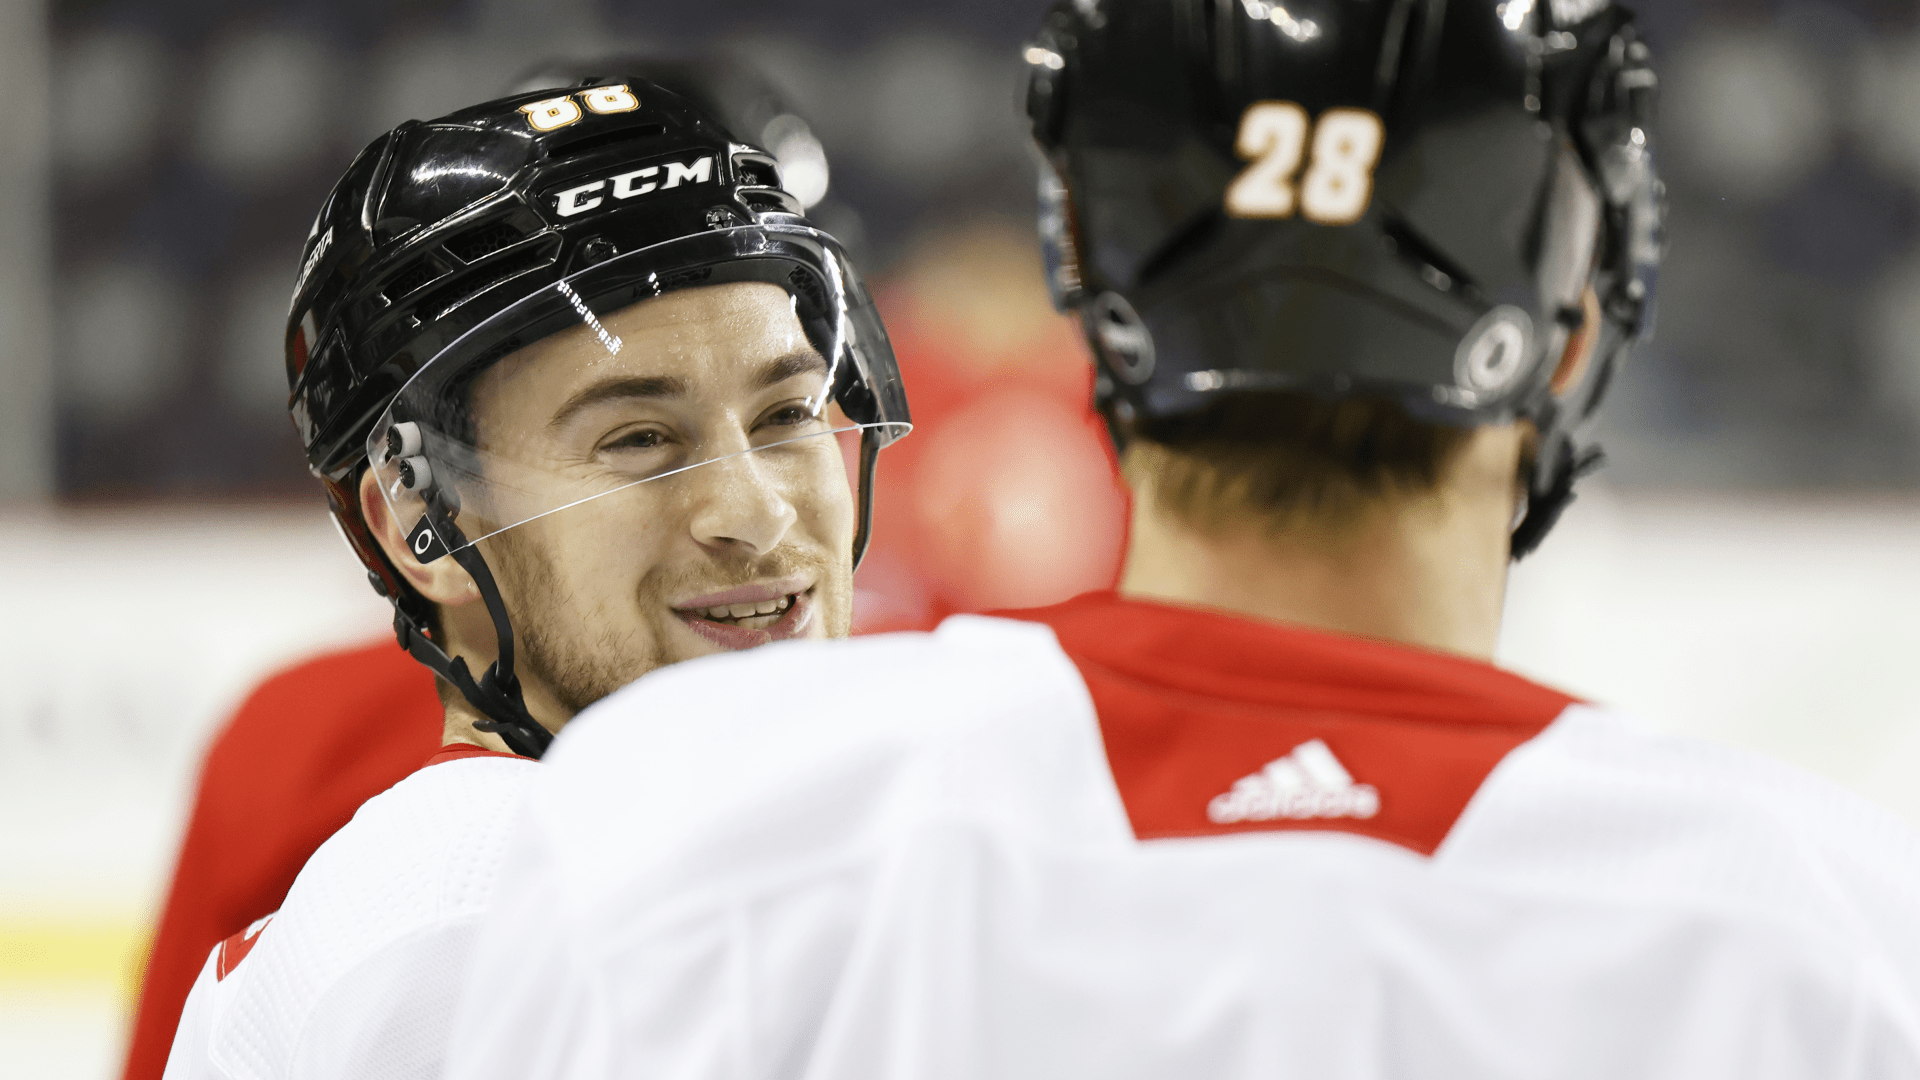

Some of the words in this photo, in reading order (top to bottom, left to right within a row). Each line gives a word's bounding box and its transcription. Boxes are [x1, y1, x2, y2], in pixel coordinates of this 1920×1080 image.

[517, 84, 641, 132] 88
[553, 156, 713, 217] CCM
[1224, 100, 1387, 226] 28
